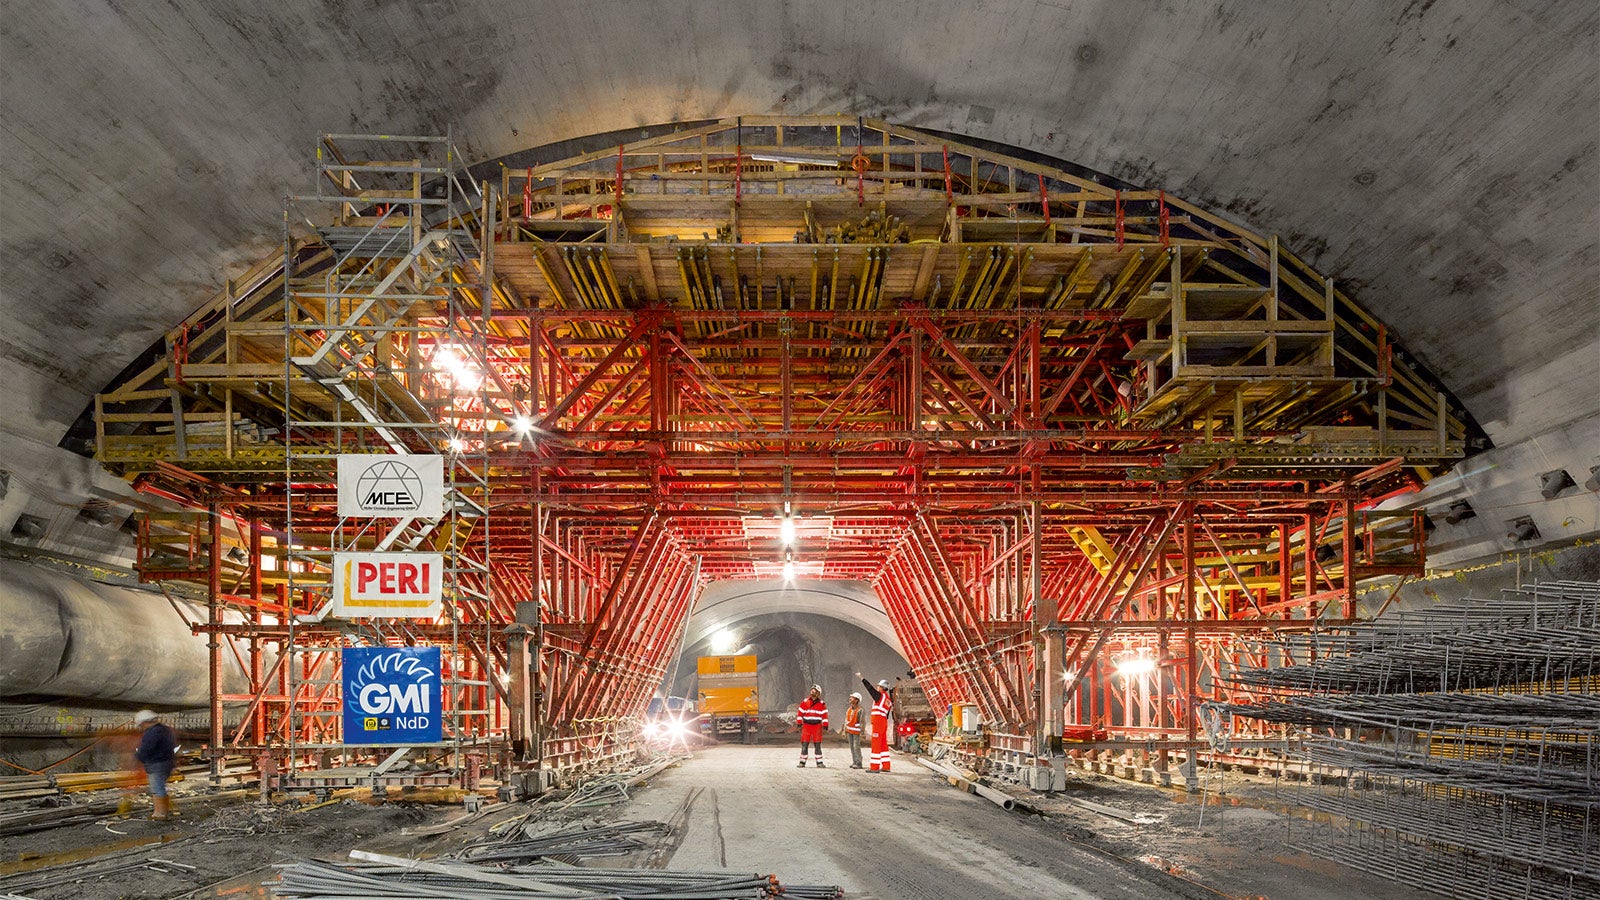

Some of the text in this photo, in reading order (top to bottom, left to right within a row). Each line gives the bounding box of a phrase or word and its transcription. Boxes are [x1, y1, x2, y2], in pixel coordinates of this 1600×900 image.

[366, 492, 413, 505] MCE
[358, 562, 430, 594] PERI
[360, 683, 430, 714] GMI
[396, 716, 429, 729] NdD
